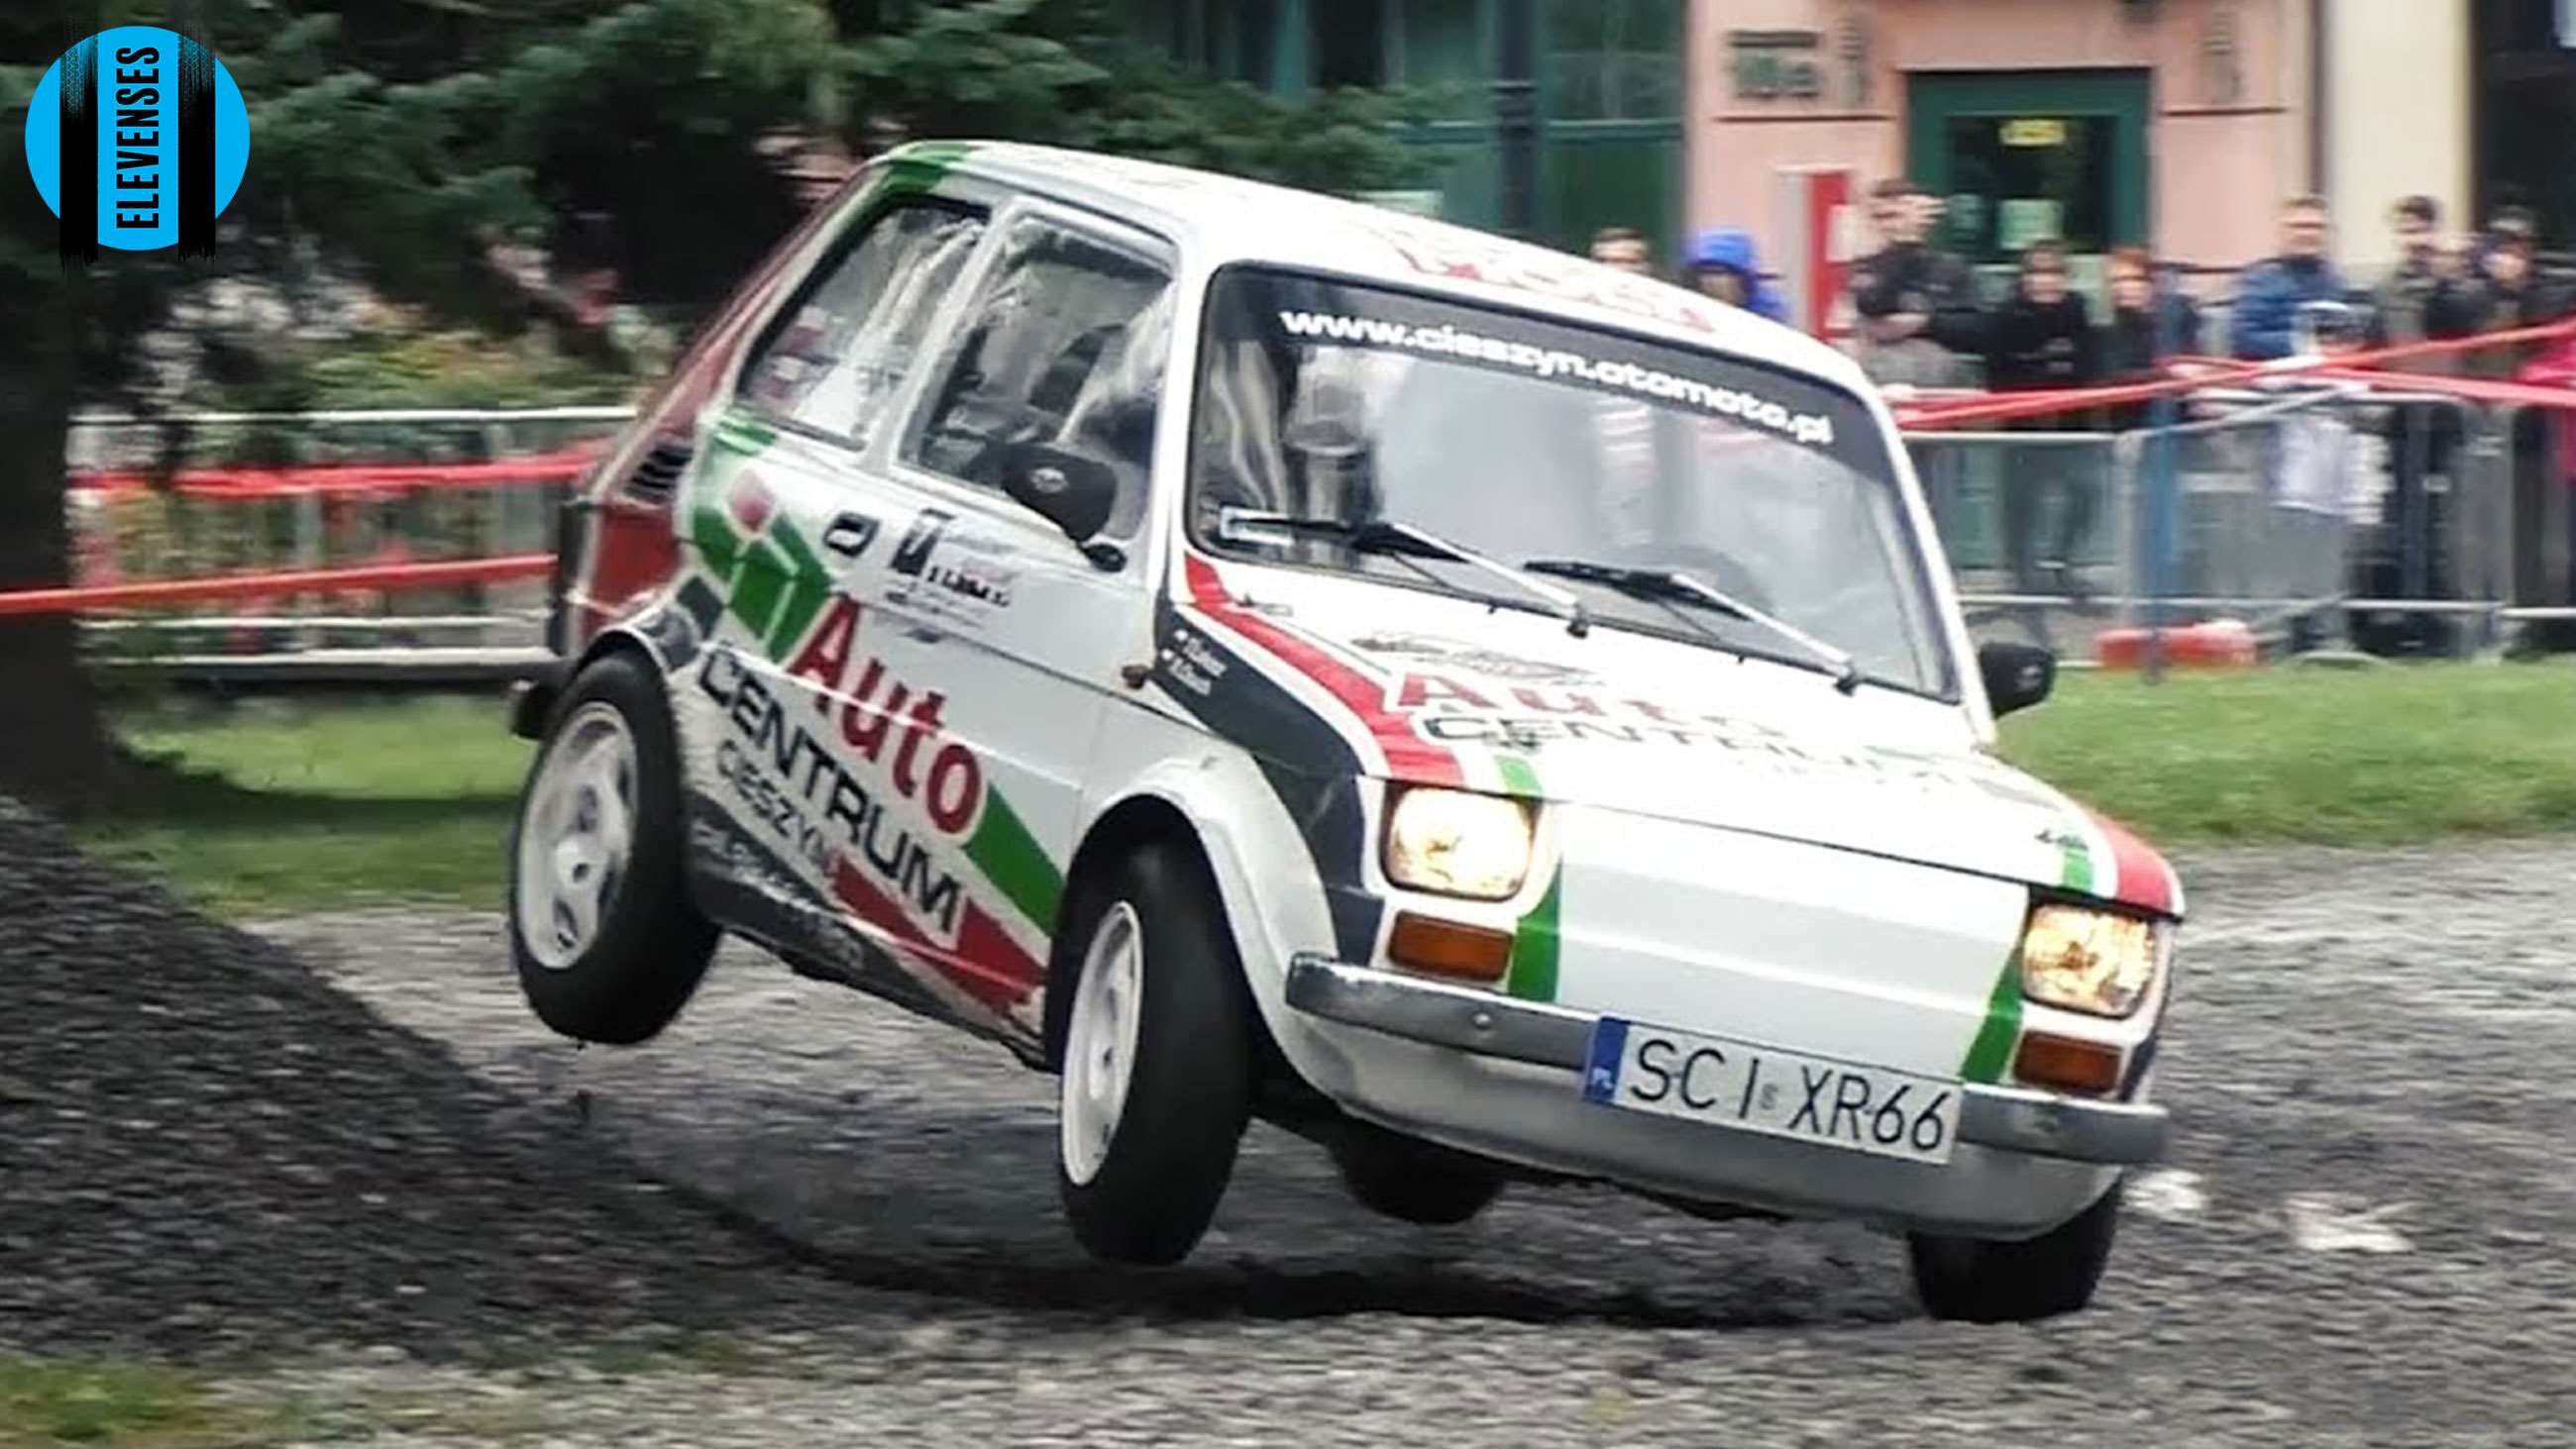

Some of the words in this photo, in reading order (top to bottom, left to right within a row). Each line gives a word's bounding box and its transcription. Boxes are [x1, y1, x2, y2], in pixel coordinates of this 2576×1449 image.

[1280, 310, 1832, 443] www.cieszyn.otomoto.pl
[699, 646, 962, 934] CENTRUM
[786, 594, 981, 834] Auto
[1630, 1039, 1760, 1120] SCI
[1787, 1065, 1952, 1151] XR66
